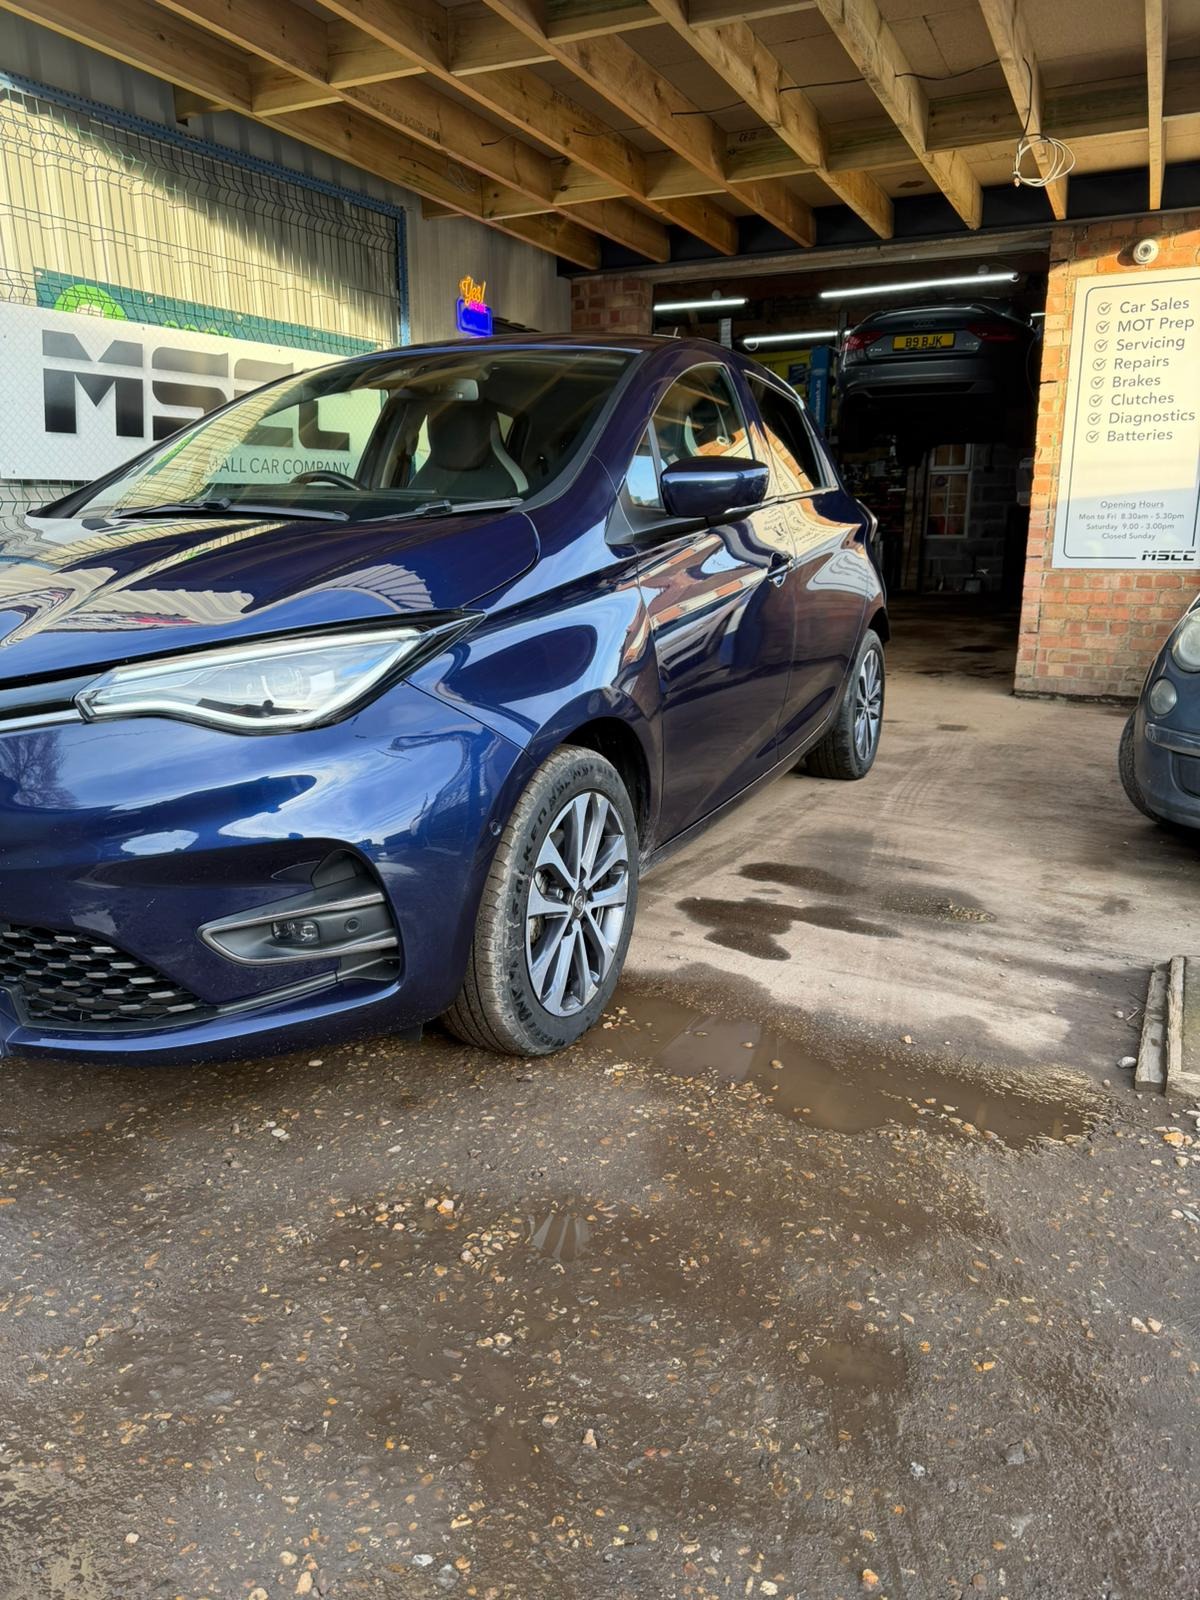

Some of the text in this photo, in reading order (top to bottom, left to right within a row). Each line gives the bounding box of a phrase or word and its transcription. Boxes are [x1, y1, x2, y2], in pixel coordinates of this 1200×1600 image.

[458, 275, 487, 307] Yes!
[1119, 297, 1190, 314] Car Sales
[1117, 317, 1195, 333] MOT Prep
[905, 336, 943, 347] B9 BJK
[1116, 336, 1186, 351] Servicing
[1114, 355, 1170, 372] Repairs
[1112, 374, 1161, 388] Brakes
[1111, 392, 1175, 406] Clutches
[1109, 409, 1196, 426] Diagnostics
[1107, 429, 1173, 442] Batteries
[249, 457, 279, 474] CAR
[282, 459, 350, 475] COMPANY
[1100, 500, 1165, 510] Opening Hours
[1106, 512, 1117, 520] Fri
[1120, 512, 1149, 520] 8.30am
[1155, 512, 1185, 521] 5.30pm
[1086, 523, 1118, 531] Saturday
[1145, 523, 1175, 531] 3.00pm
[1101, 532, 1156, 541] Closed Sunday
[1141, 550, 1197, 561] MSCC
